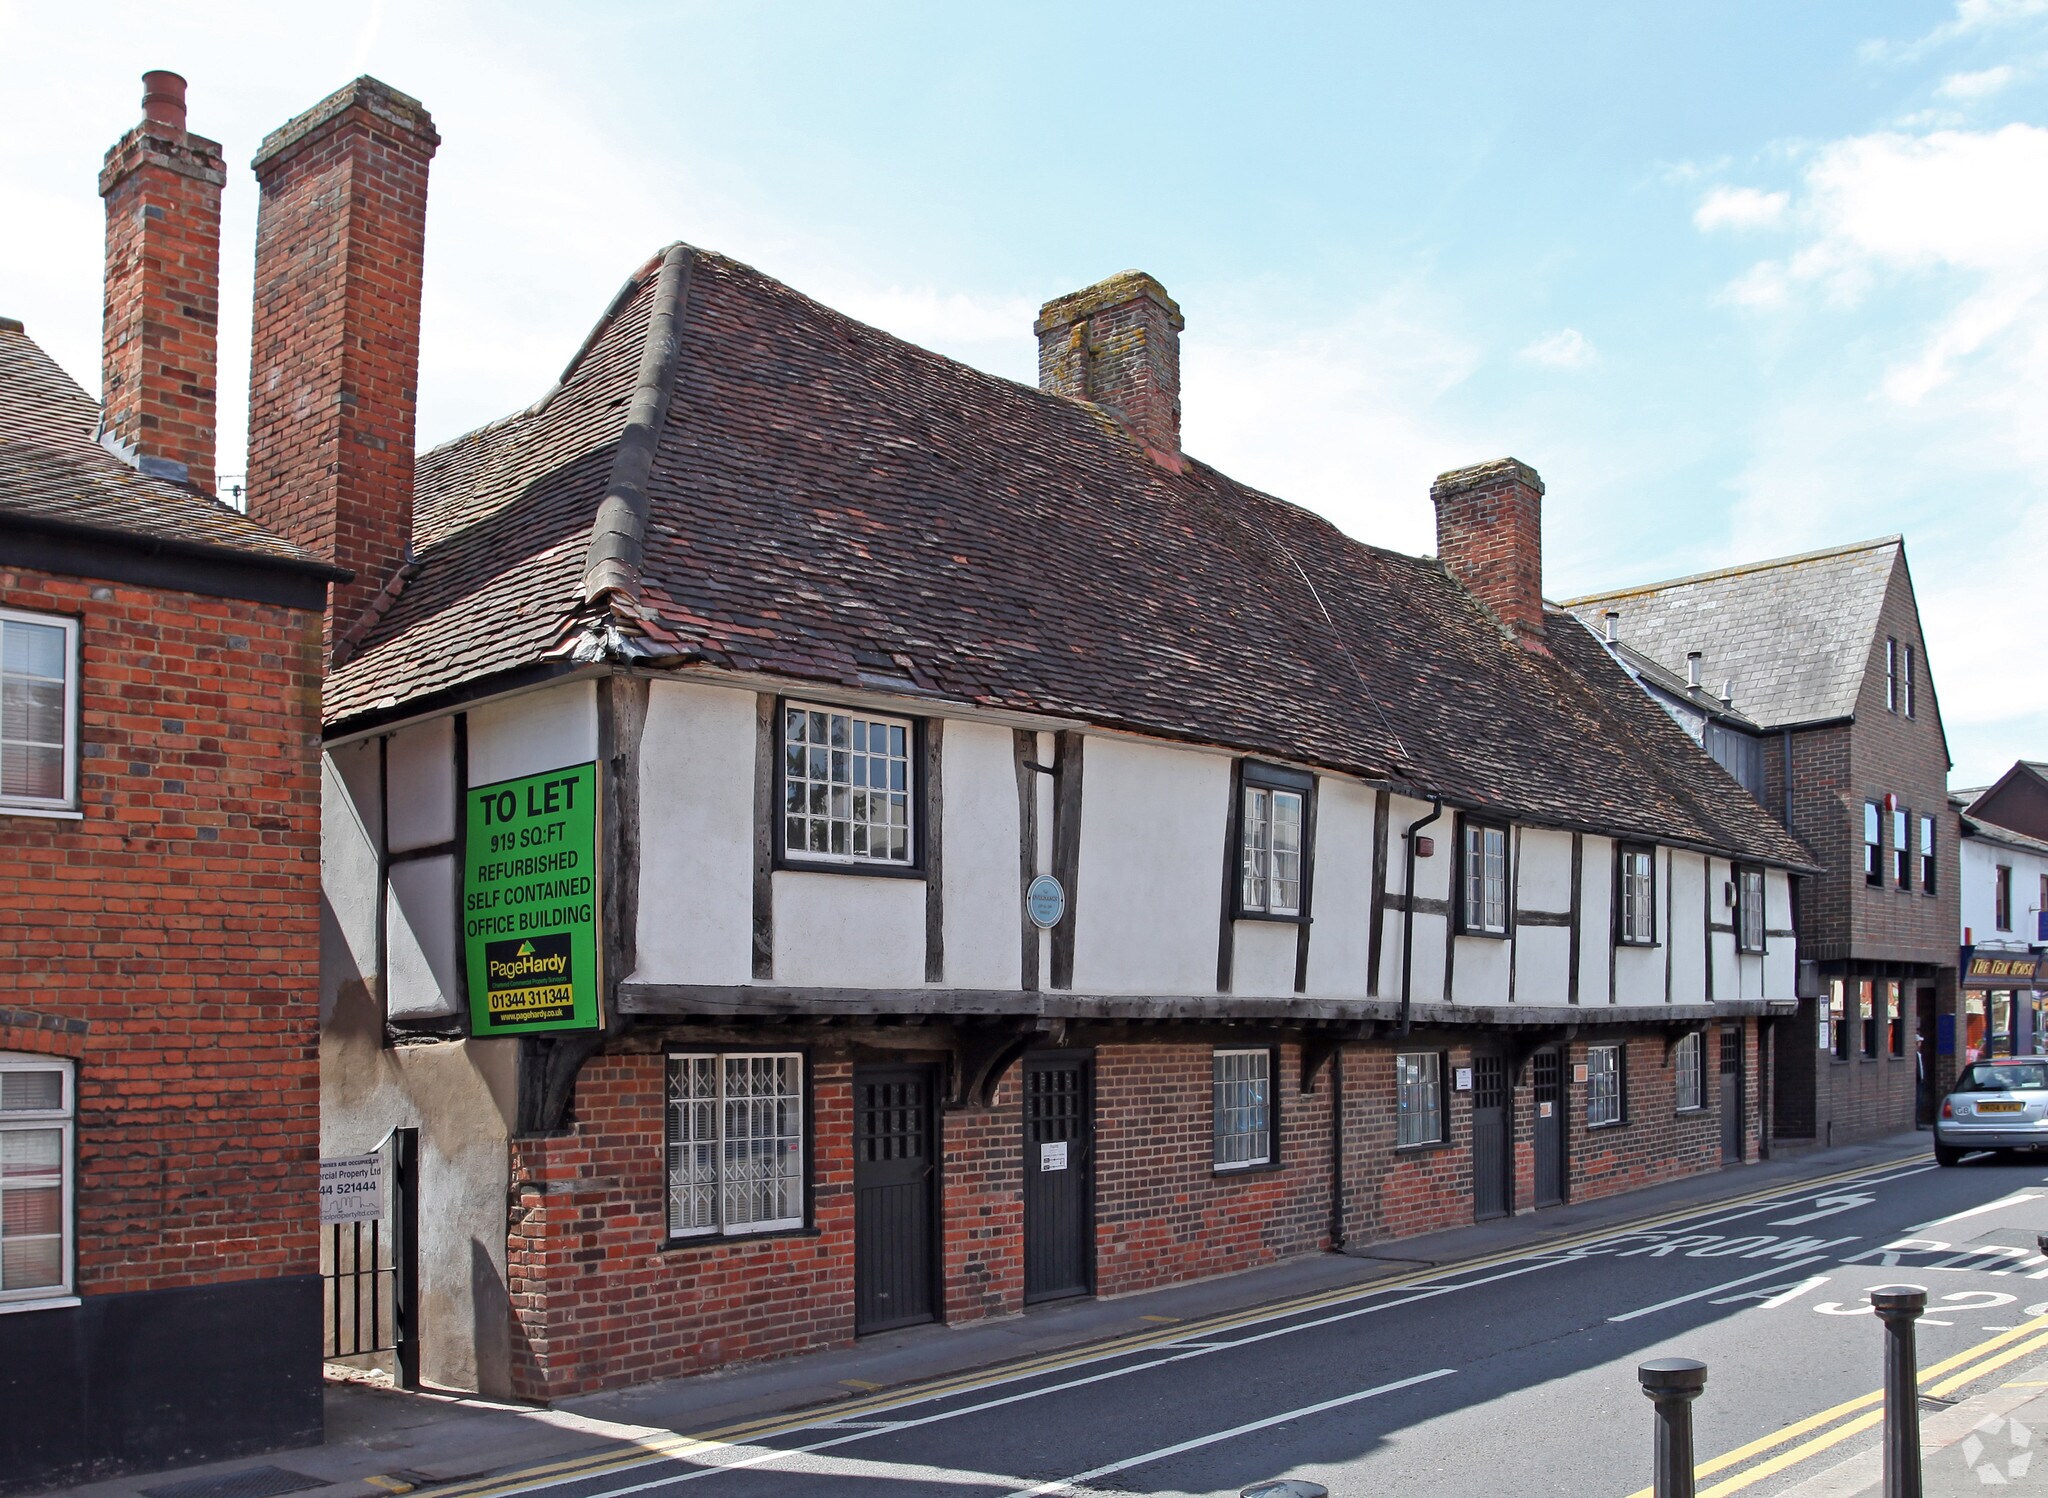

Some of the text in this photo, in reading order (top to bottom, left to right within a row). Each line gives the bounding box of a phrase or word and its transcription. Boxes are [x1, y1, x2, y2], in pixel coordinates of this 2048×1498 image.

[480, 776, 580, 826] TO LET
[490, 832, 516, 853] 919
[478, 850, 579, 883] REFURBISHED
[467, 876, 591, 911] SELF CONTAINED
[467, 904, 591, 938] OFFICE BUILDING
[490, 953, 567, 979] PageHardy
[1973, 959, 1990, 974] THE
[2011, 960, 2036, 976] HOUSE
[491, 987, 570, 1009] 01344 311344
[500, 1008, 563, 1021] www.pagehardy.co.uk
[1957, 1106, 1969, 1114] GB
[339, 1169, 368, 1179] Property
[370, 1167, 381, 1176] Ltd
[337, 1181, 376, 1194] 521444
